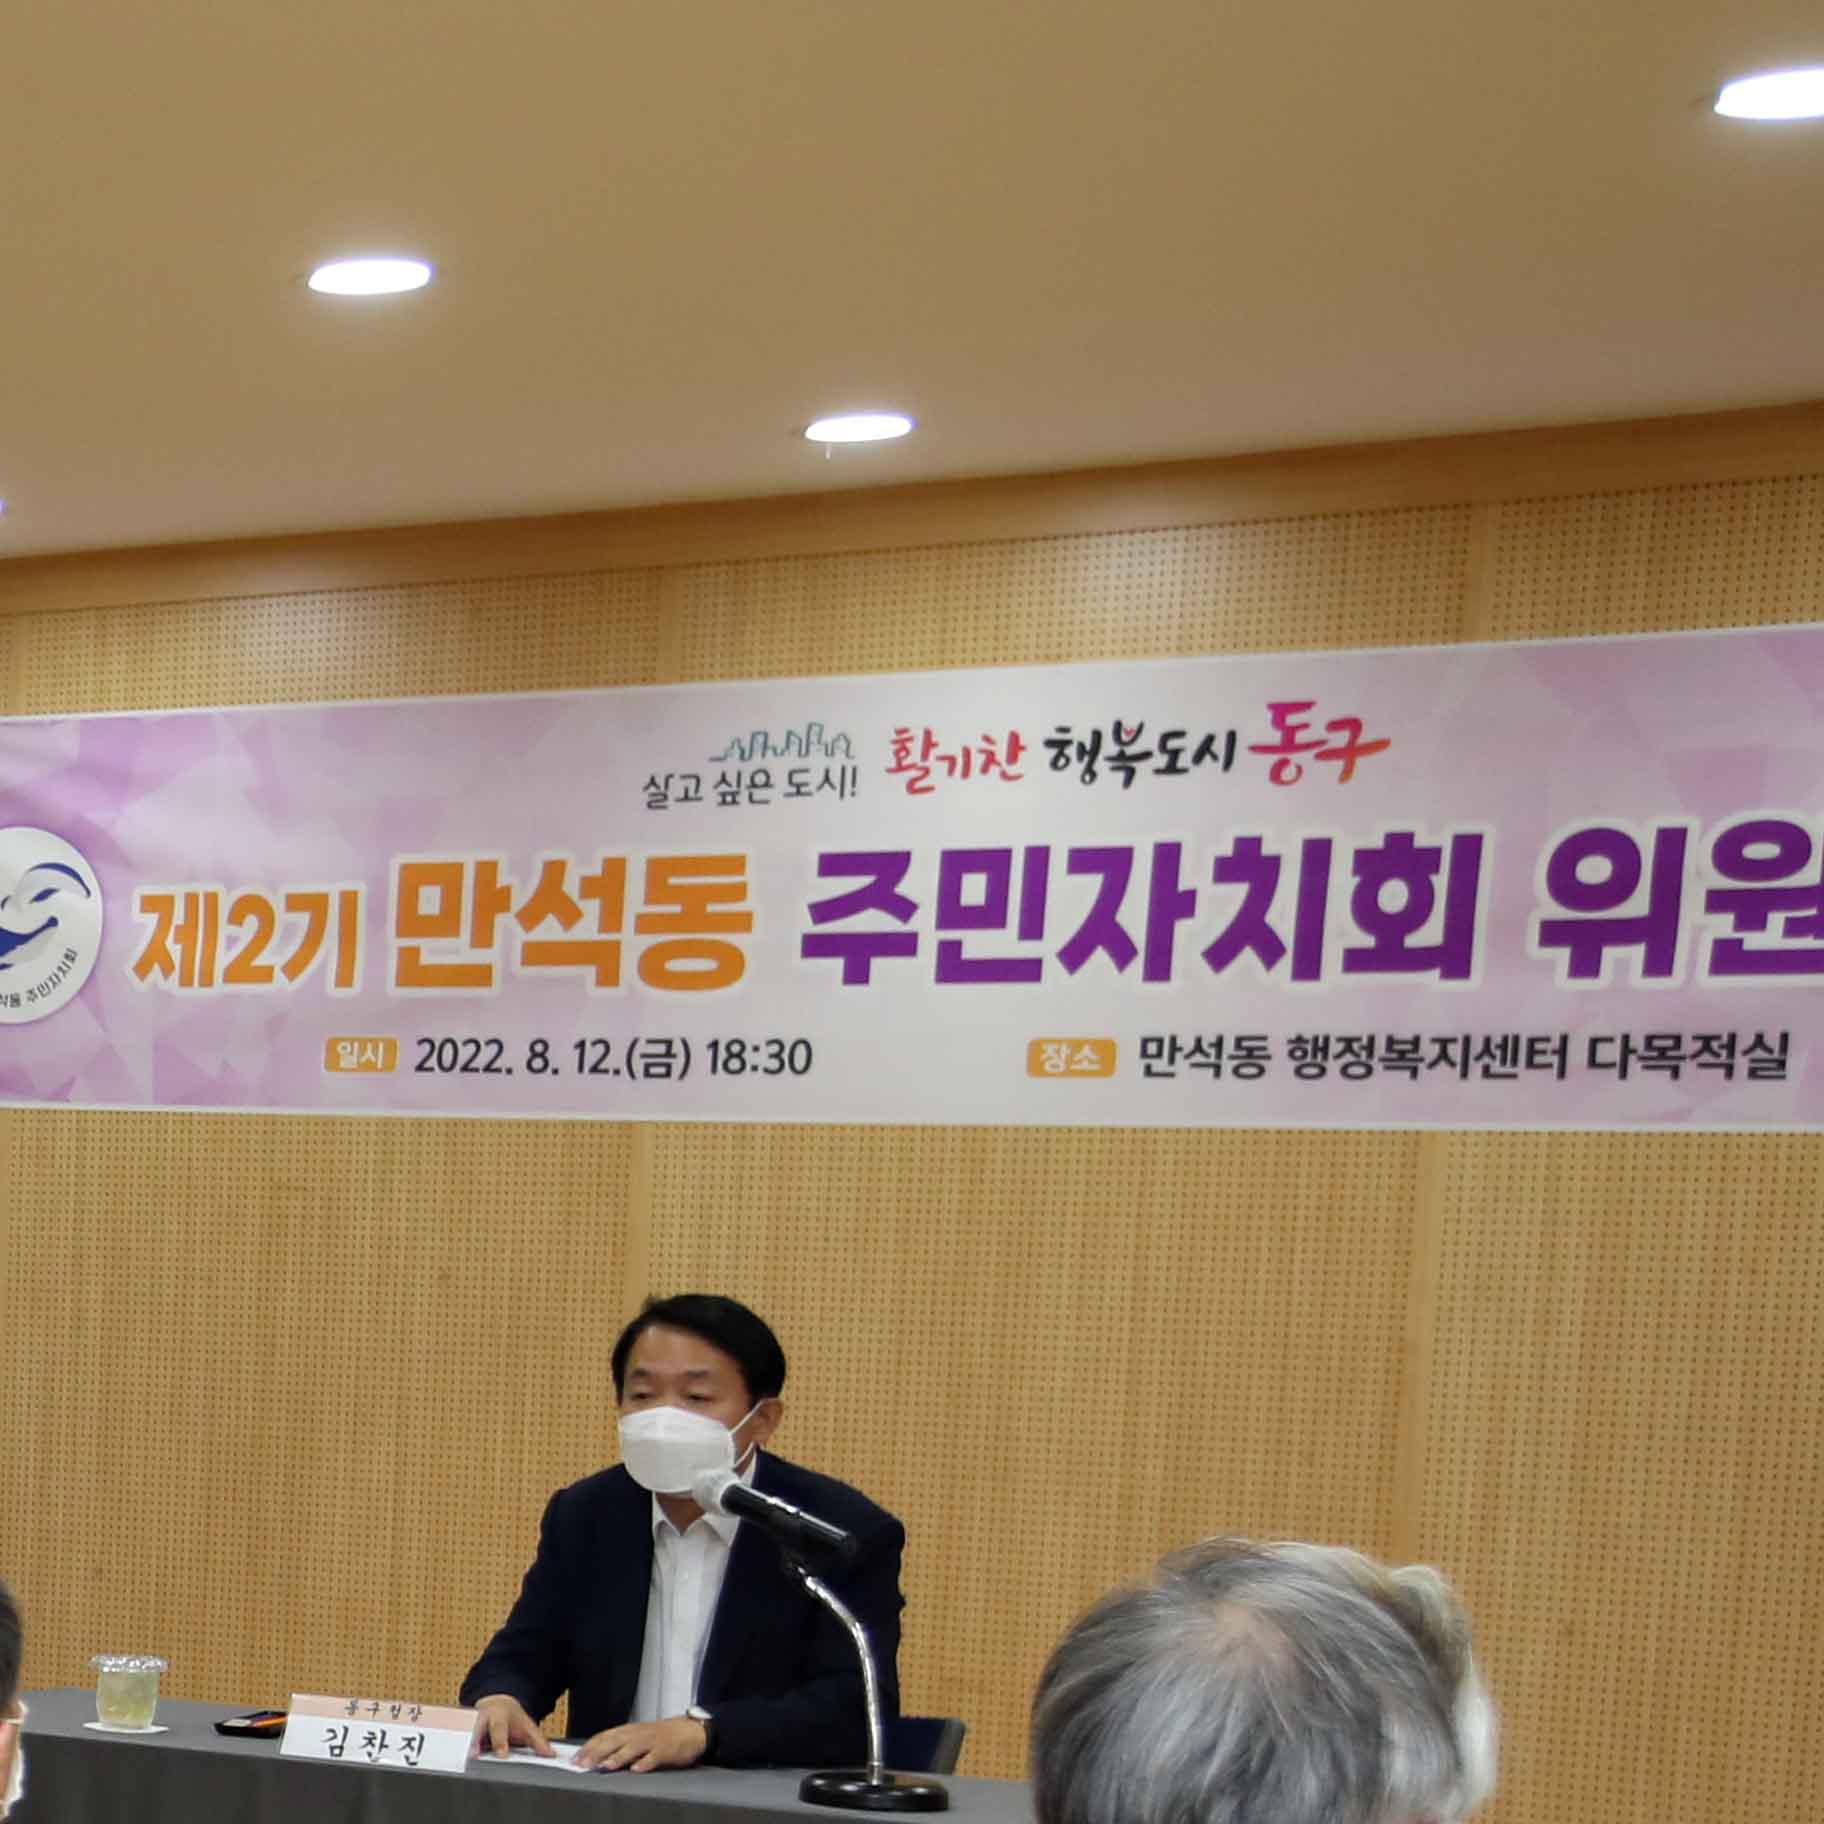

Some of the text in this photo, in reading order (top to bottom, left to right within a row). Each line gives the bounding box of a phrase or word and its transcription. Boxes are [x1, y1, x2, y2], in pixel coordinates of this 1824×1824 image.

[885, 700, 1393, 796] 활기찬 행복도시 동구
[643, 765, 858, 810] 살고 싶은 도시!
[132, 888, 360, 989] 제2기
[394, 852, 755, 992] 만석동
[800, 831, 1485, 987] 주민자치회
[335, 1036, 814, 1083] 일시 2022. 8. 12.(금) 18:30
[1039, 1030, 1791, 1083] 장소 만석동 행정복지센터 다목적실
